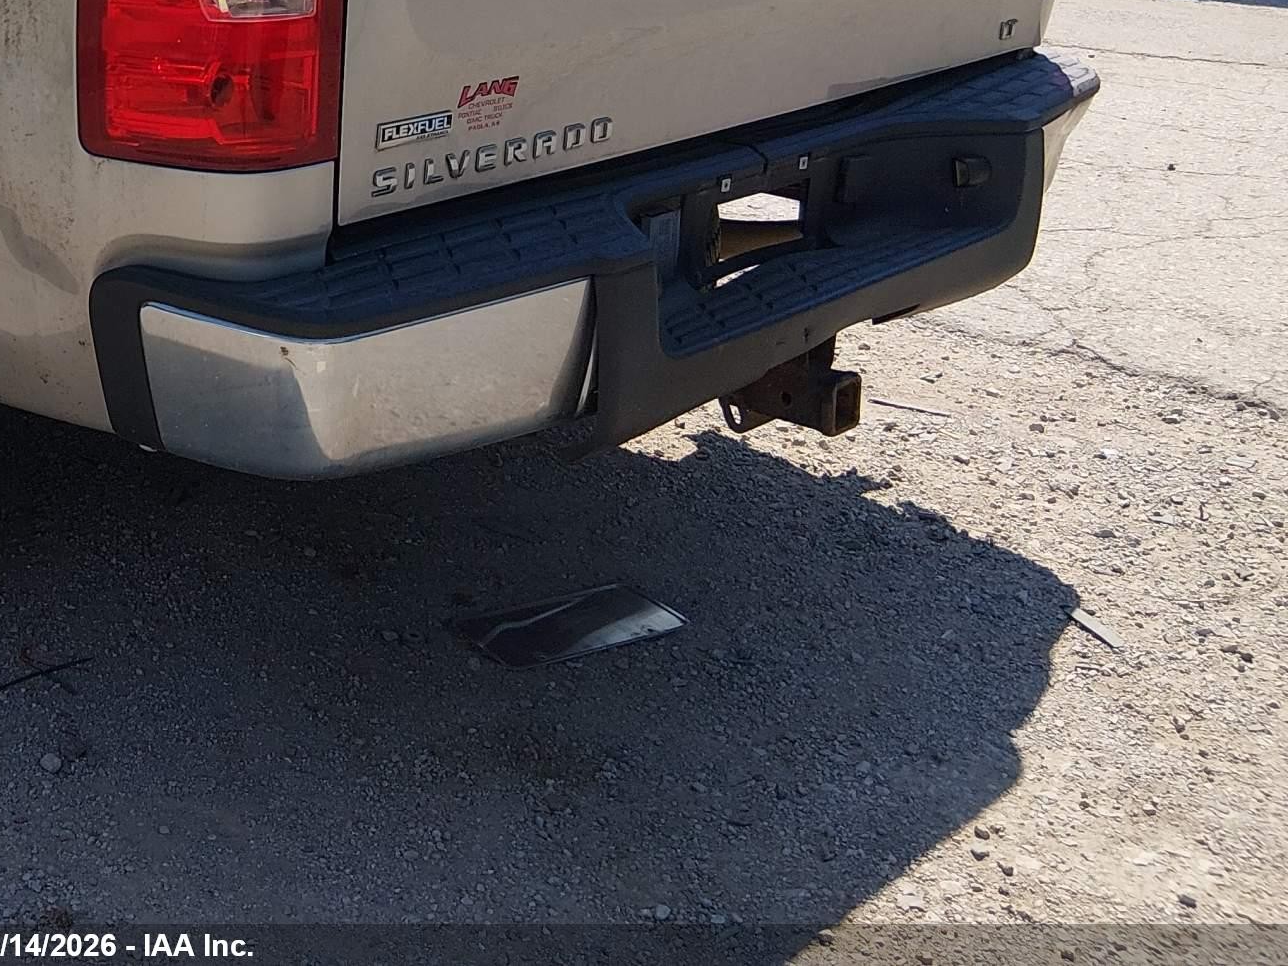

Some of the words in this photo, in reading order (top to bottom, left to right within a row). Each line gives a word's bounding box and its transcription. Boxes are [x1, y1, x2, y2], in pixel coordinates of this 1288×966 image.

[457, 75, 520, 109] LANG
[384, 117, 451, 141] FLEXFUEL
[371, 116, 613, 198] SILVERADO
